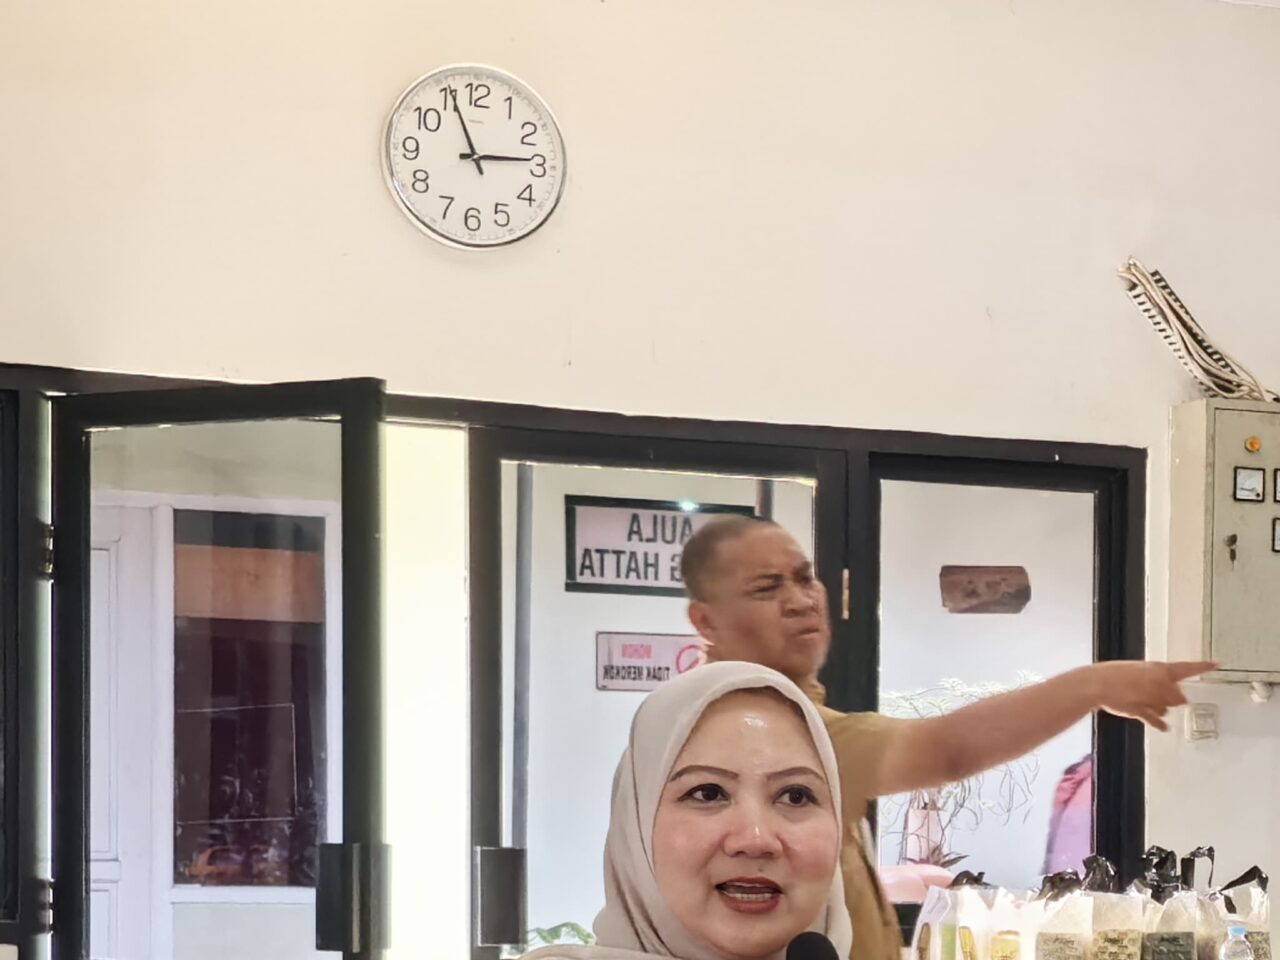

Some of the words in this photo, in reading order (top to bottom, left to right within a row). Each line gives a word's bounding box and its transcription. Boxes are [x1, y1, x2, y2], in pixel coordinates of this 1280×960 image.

[439, 86, 458, 113] 11
[465, 82, 491, 109] 12
[503, 95, 513, 121] 1
[413, 106, 442, 133] 10
[520, 121, 538, 146] 2
[402, 136, 420, 161] 9
[529, 153, 547, 178] 3
[411, 169, 430, 194] 8
[438, 195, 455, 221] 7
[516, 183, 537, 208] 4
[464, 207, 481, 232] 6
[493, 202, 511, 228] 5
